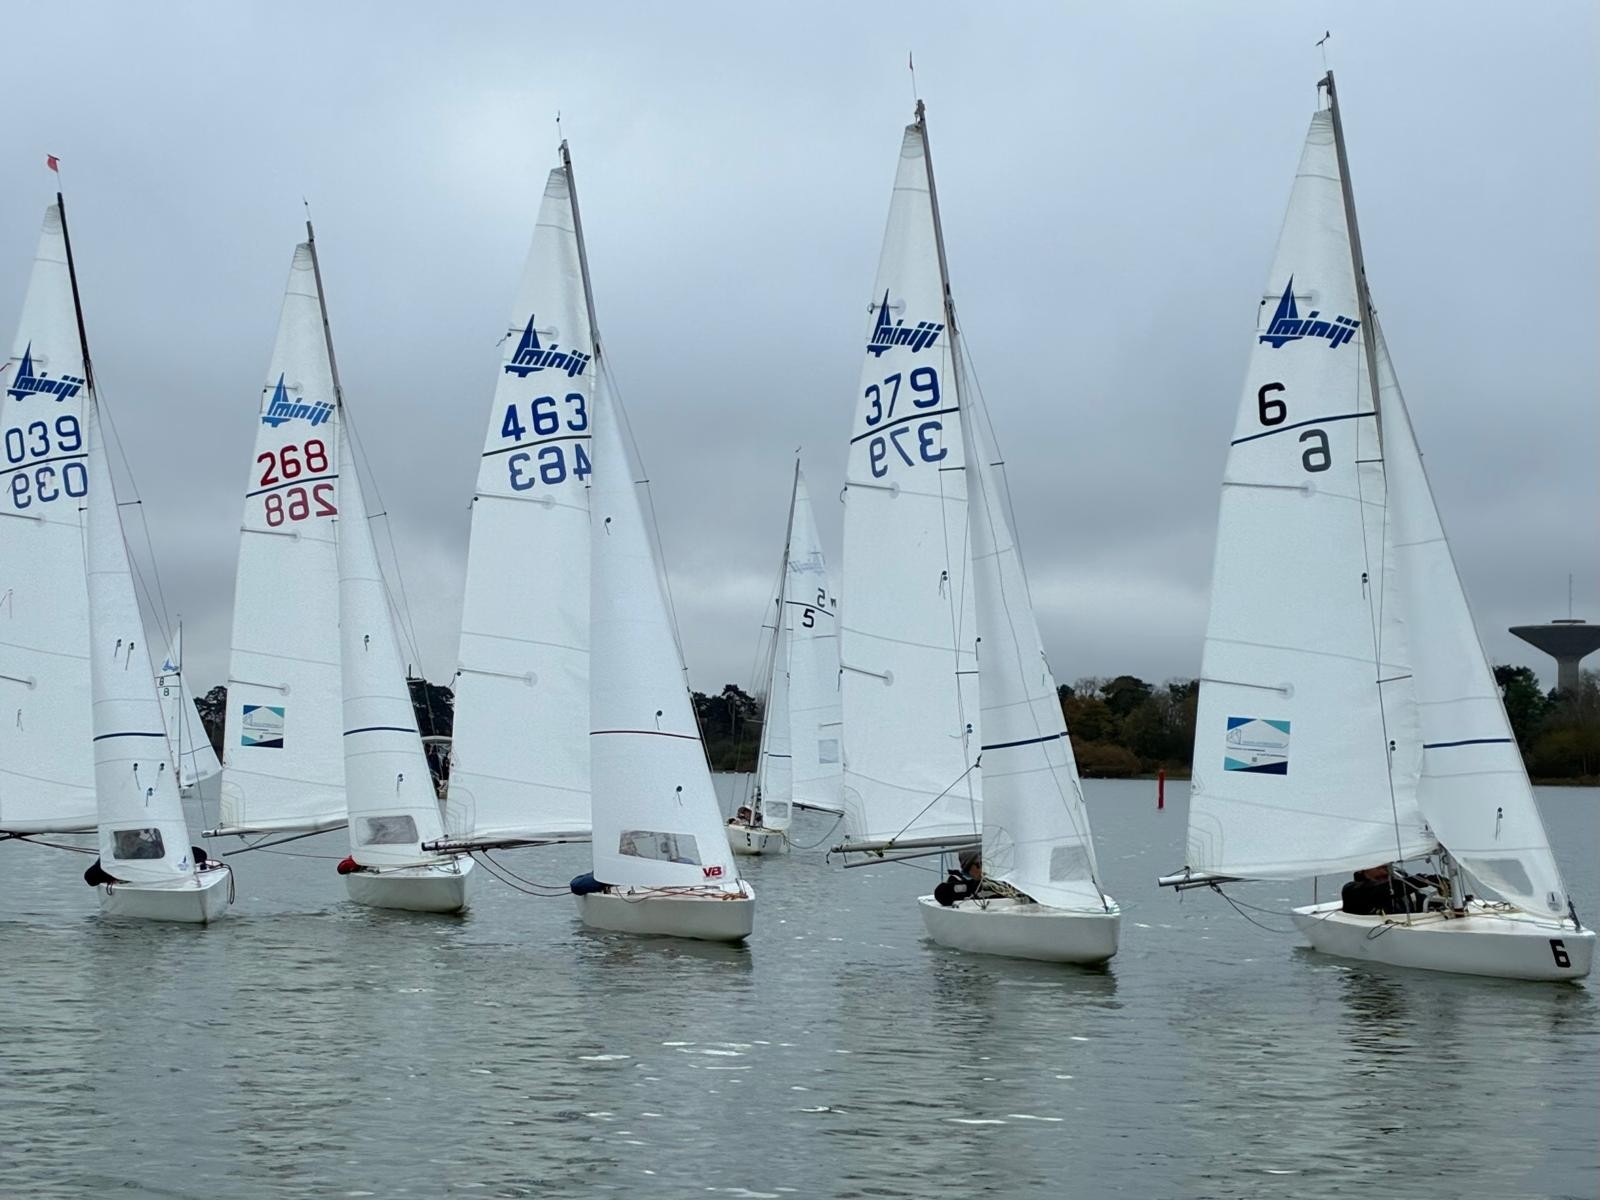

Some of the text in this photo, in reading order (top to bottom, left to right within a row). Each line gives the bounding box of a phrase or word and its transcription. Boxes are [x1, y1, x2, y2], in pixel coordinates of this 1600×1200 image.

[501, 393, 588, 442] 463
[864, 366, 940, 426] 379
[1257, 382, 1287, 426] 6
[5, 415, 82, 464] 039
[256, 439, 328, 487] 268
[802, 608, 815, 628] 5
[164, 687, 170, 696] 8
[746, 832, 752, 847] 5
[1549, 939, 1571, 968] 6
